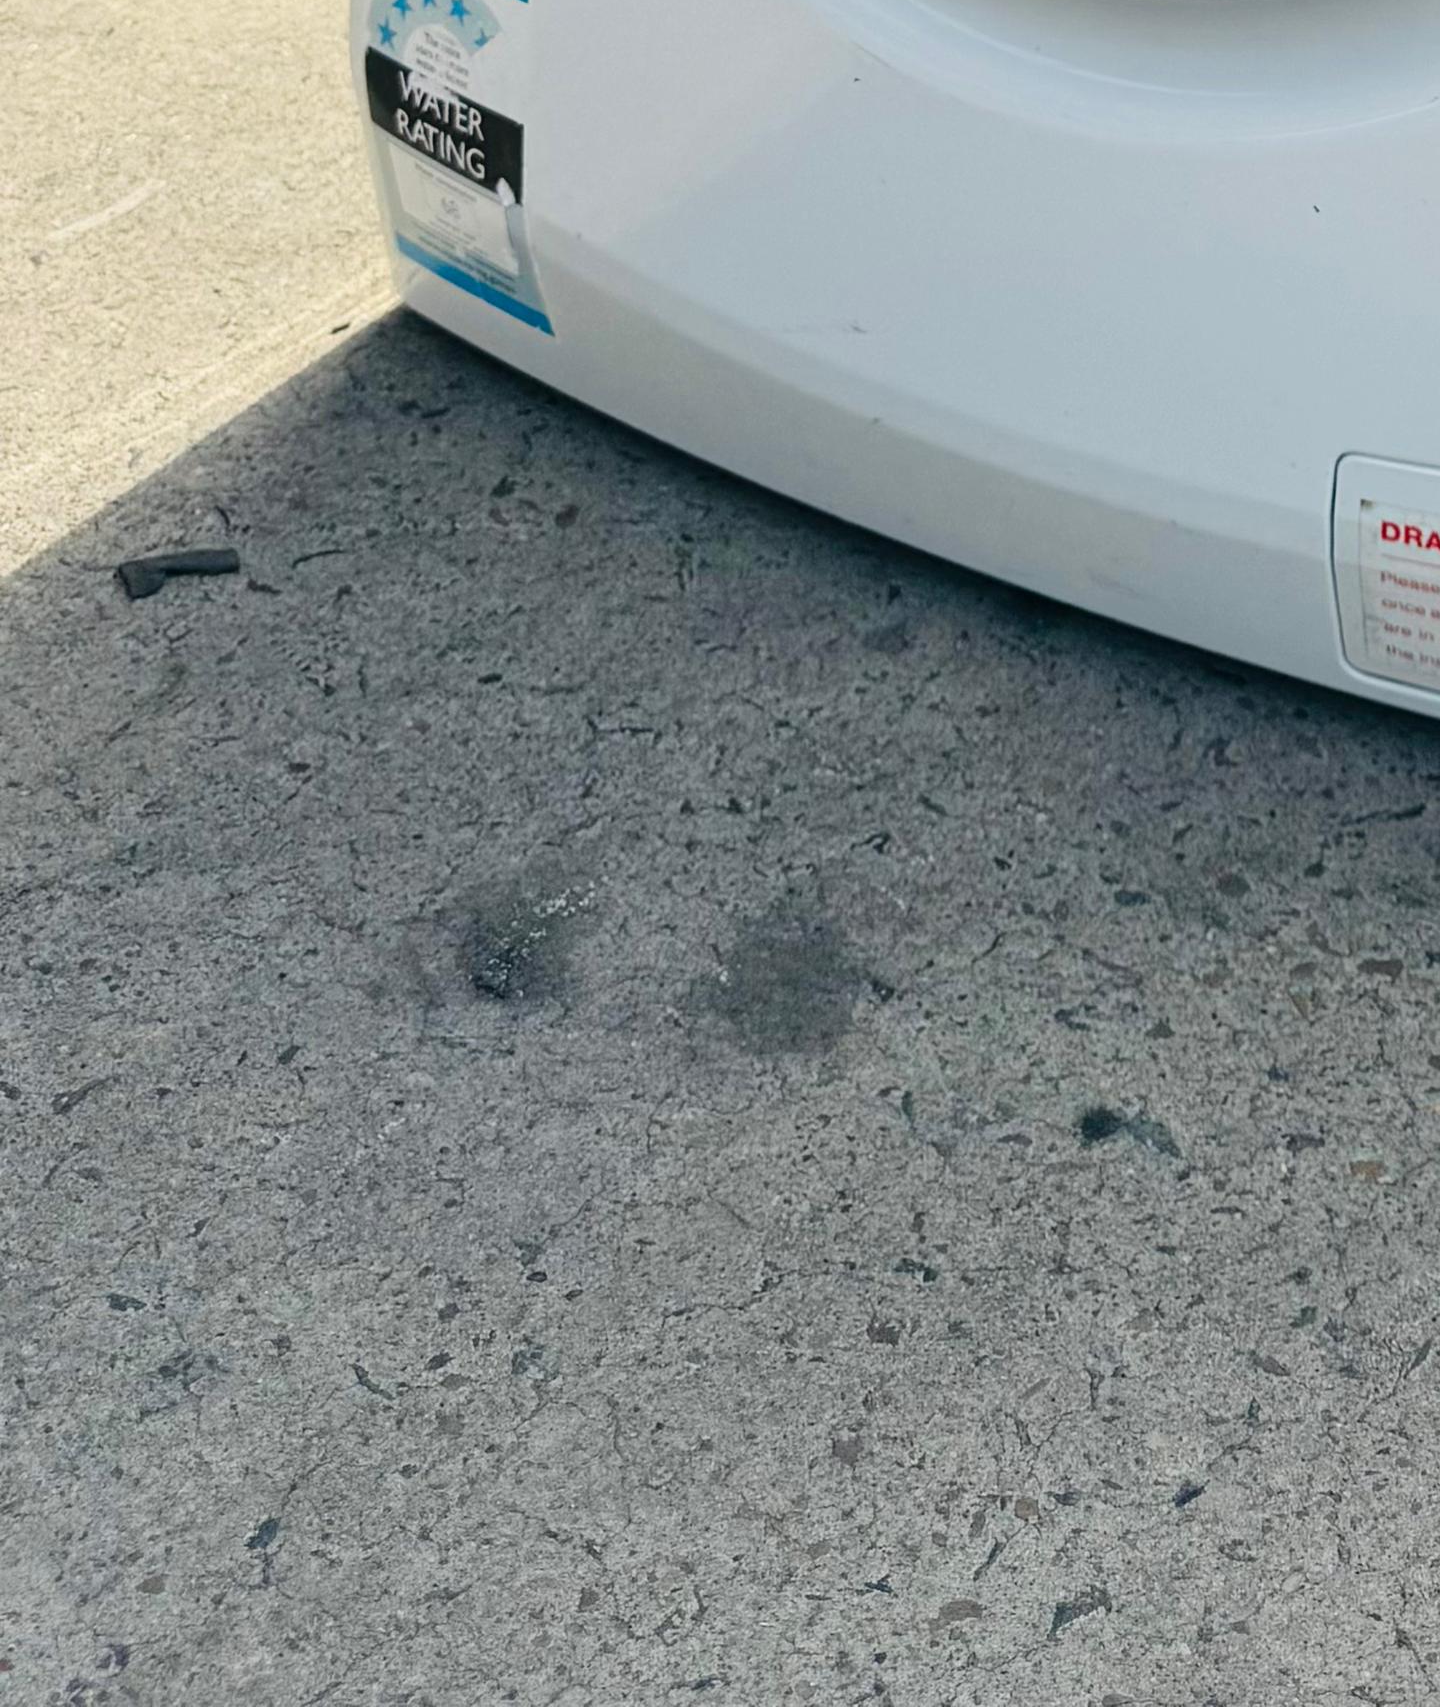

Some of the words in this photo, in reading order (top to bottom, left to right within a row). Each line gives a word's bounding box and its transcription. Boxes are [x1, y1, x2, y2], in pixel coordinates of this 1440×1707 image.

[398, 70, 485, 141] WATER
[396, 108, 486, 181] RATING
[1380, 571, 1440, 594] Please
[1382, 598, 1426, 616] once
[1430, 608, 1440, 620] a
[1384, 622, 1412, 637] are
[1419, 628, 1435, 642] in
[1386, 644, 1414, 661] the
